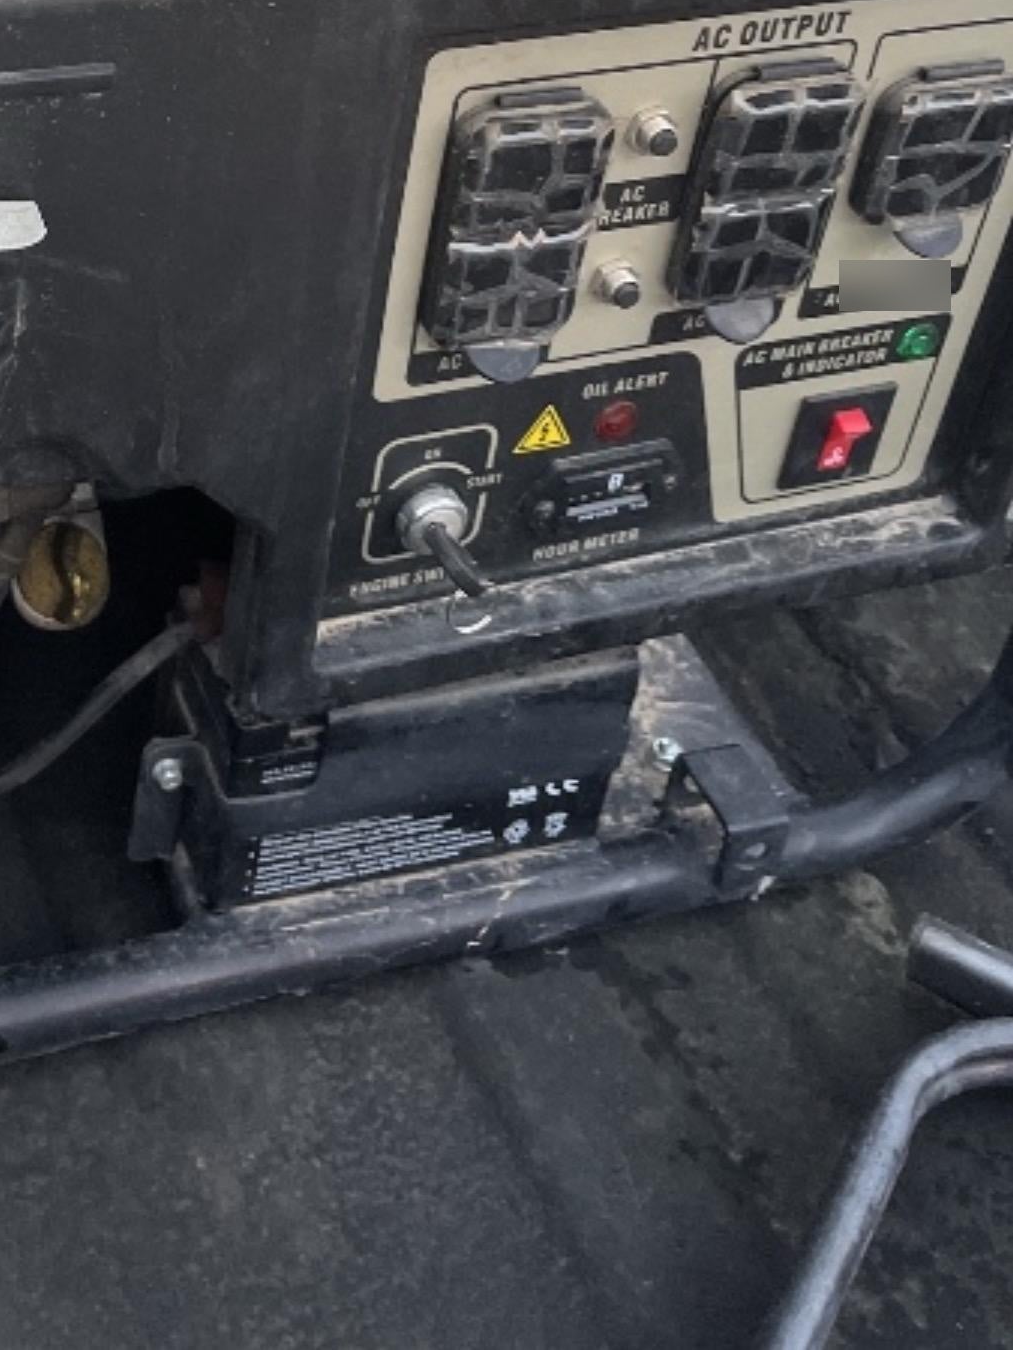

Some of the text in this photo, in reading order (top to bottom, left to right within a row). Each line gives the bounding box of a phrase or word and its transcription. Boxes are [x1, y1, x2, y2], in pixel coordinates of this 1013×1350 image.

[692, 10, 852, 52] AC OUTPUT
[620, 185, 646, 203] AC
[596, 201, 670, 227] REAKER
[769, 341, 815, 361] MAIN
[817, 328, 895, 354] BREAKER
[797, 347, 888, 376] INDICATOR
[614, 371, 669, 394] ALERT
